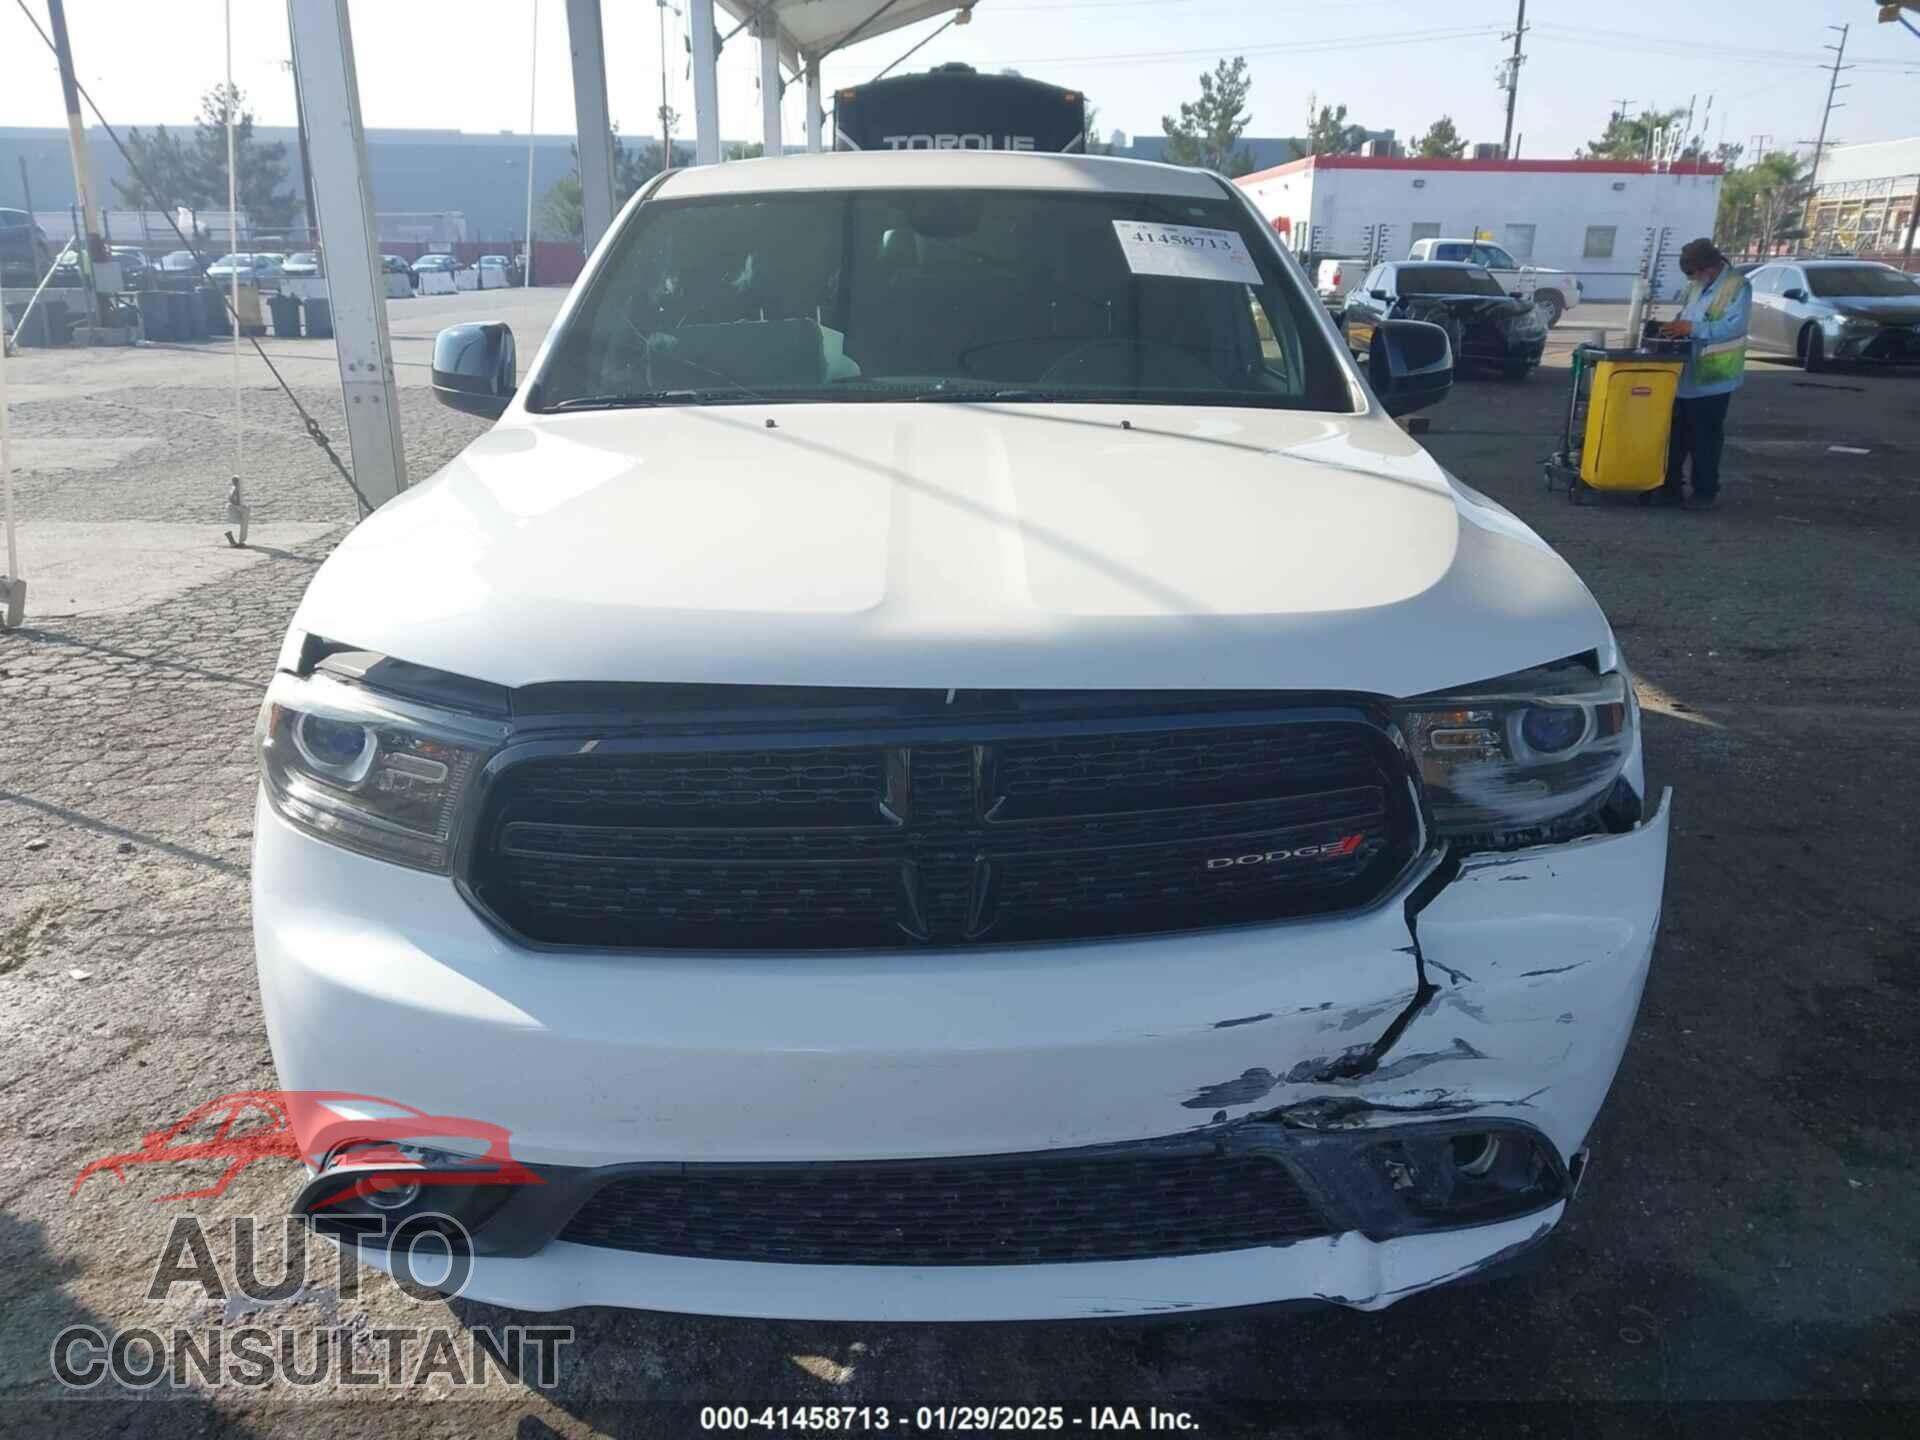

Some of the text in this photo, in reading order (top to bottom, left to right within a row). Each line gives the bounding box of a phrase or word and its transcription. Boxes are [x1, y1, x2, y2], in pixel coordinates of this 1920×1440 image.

[883, 134, 1035, 151] TORQUE
[1131, 231, 1232, 251] 41458713
[1207, 841, 1346, 869] DODGE
